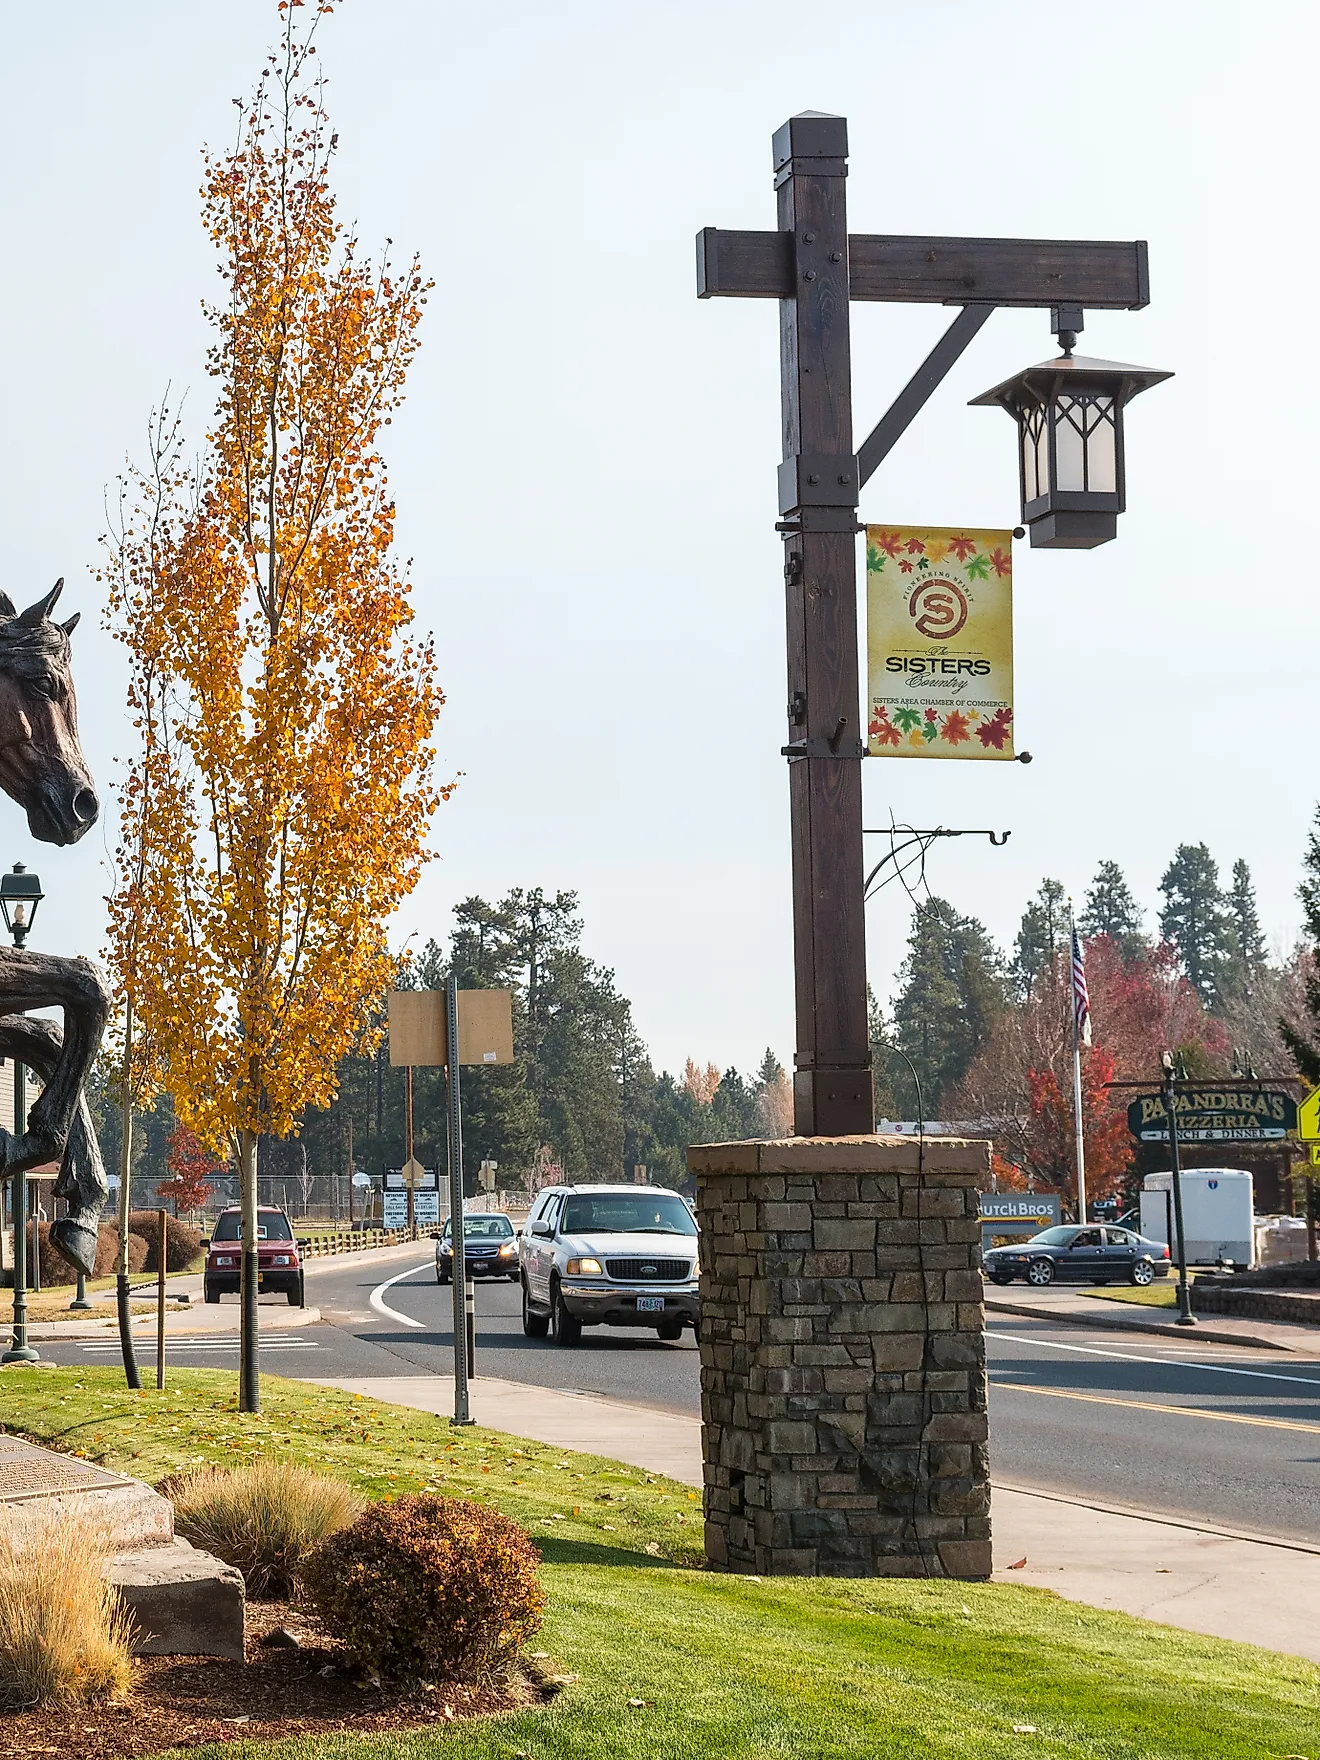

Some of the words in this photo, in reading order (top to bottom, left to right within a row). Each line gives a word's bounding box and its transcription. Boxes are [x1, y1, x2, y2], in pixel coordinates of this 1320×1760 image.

[903, 571, 950, 600] PIONEERING
[953, 576, 974, 602] SPIRIT
[925, 645, 949, 656] The
[885, 656, 991, 676] SISTERS
[905, 671, 968, 695] Country
[872, 697, 899, 705] SISTERS
[900, 697, 919, 706] AREA
[919, 698, 954, 707] CHAMBER
[955, 699, 965, 707] OF
[966, 700, 1008, 708] COMMERCE
[1166, 1115, 1260, 1130] IZZERIA
[1160, 1130, 1199, 1139] LNCH
[1205, 1130, 1214, 1139] &
[1222, 1129, 1267, 1138] DINNER
[1019, 1203, 1054, 1215] BROS
